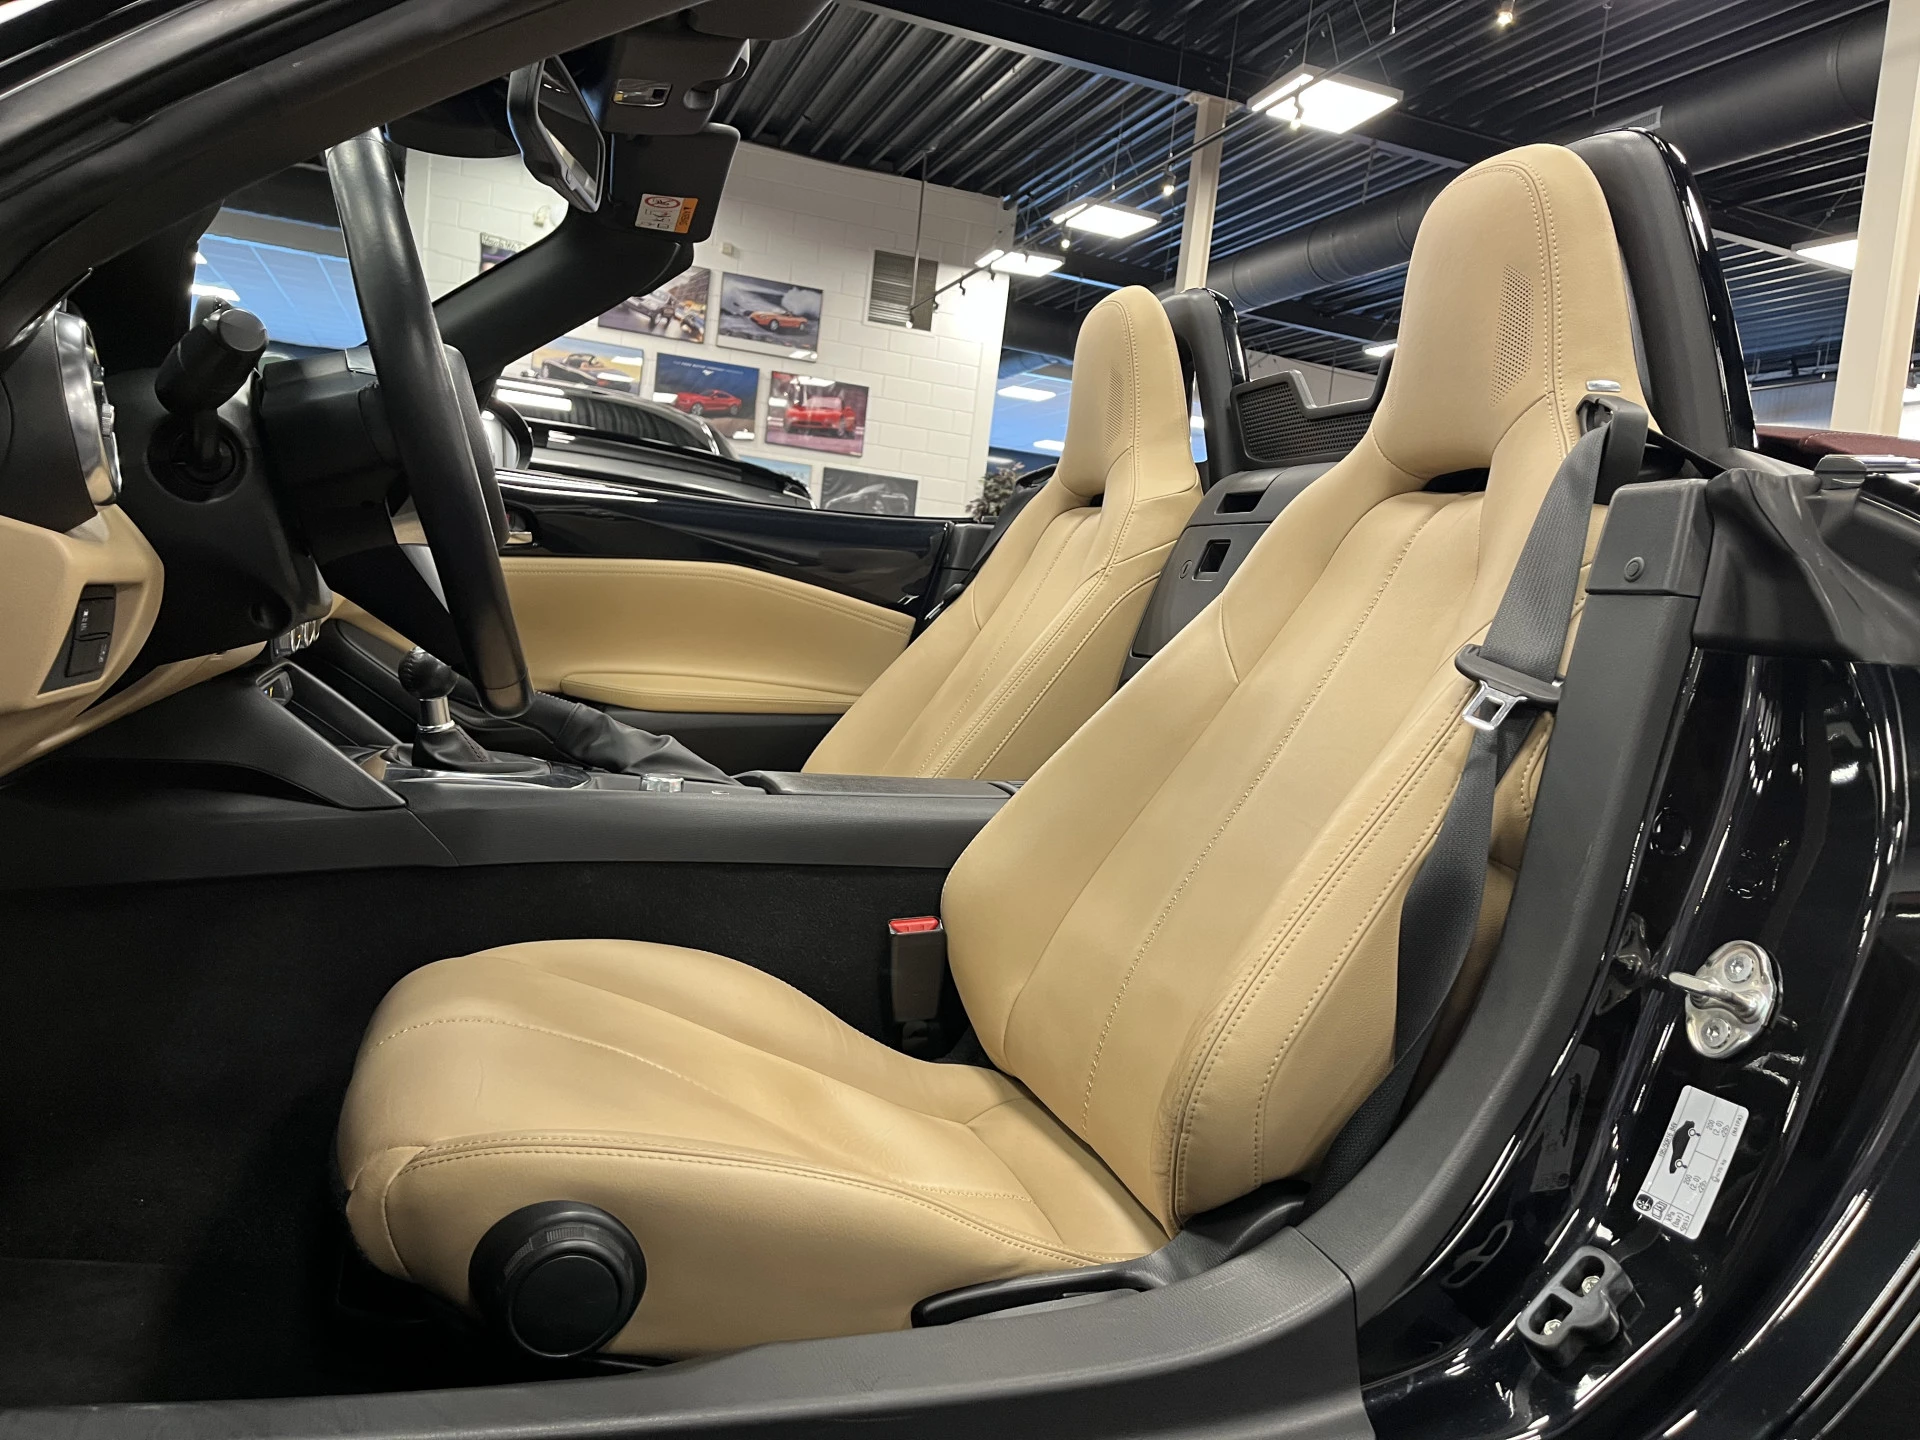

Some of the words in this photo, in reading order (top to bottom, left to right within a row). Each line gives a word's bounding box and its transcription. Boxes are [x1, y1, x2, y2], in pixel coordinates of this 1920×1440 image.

[1706, 1119, 1715, 1131] 200
[1712, 1120, 1724, 1136] (2.0)
[1683, 1174, 1692, 1186] 200
[1689, 1175, 1701, 1191] (2.0)
[1666, 1211, 1676, 1223] kPa
[1672, 1212, 1684, 1228] (bar)
[1680, 1215, 1690, 1232] <psi>
